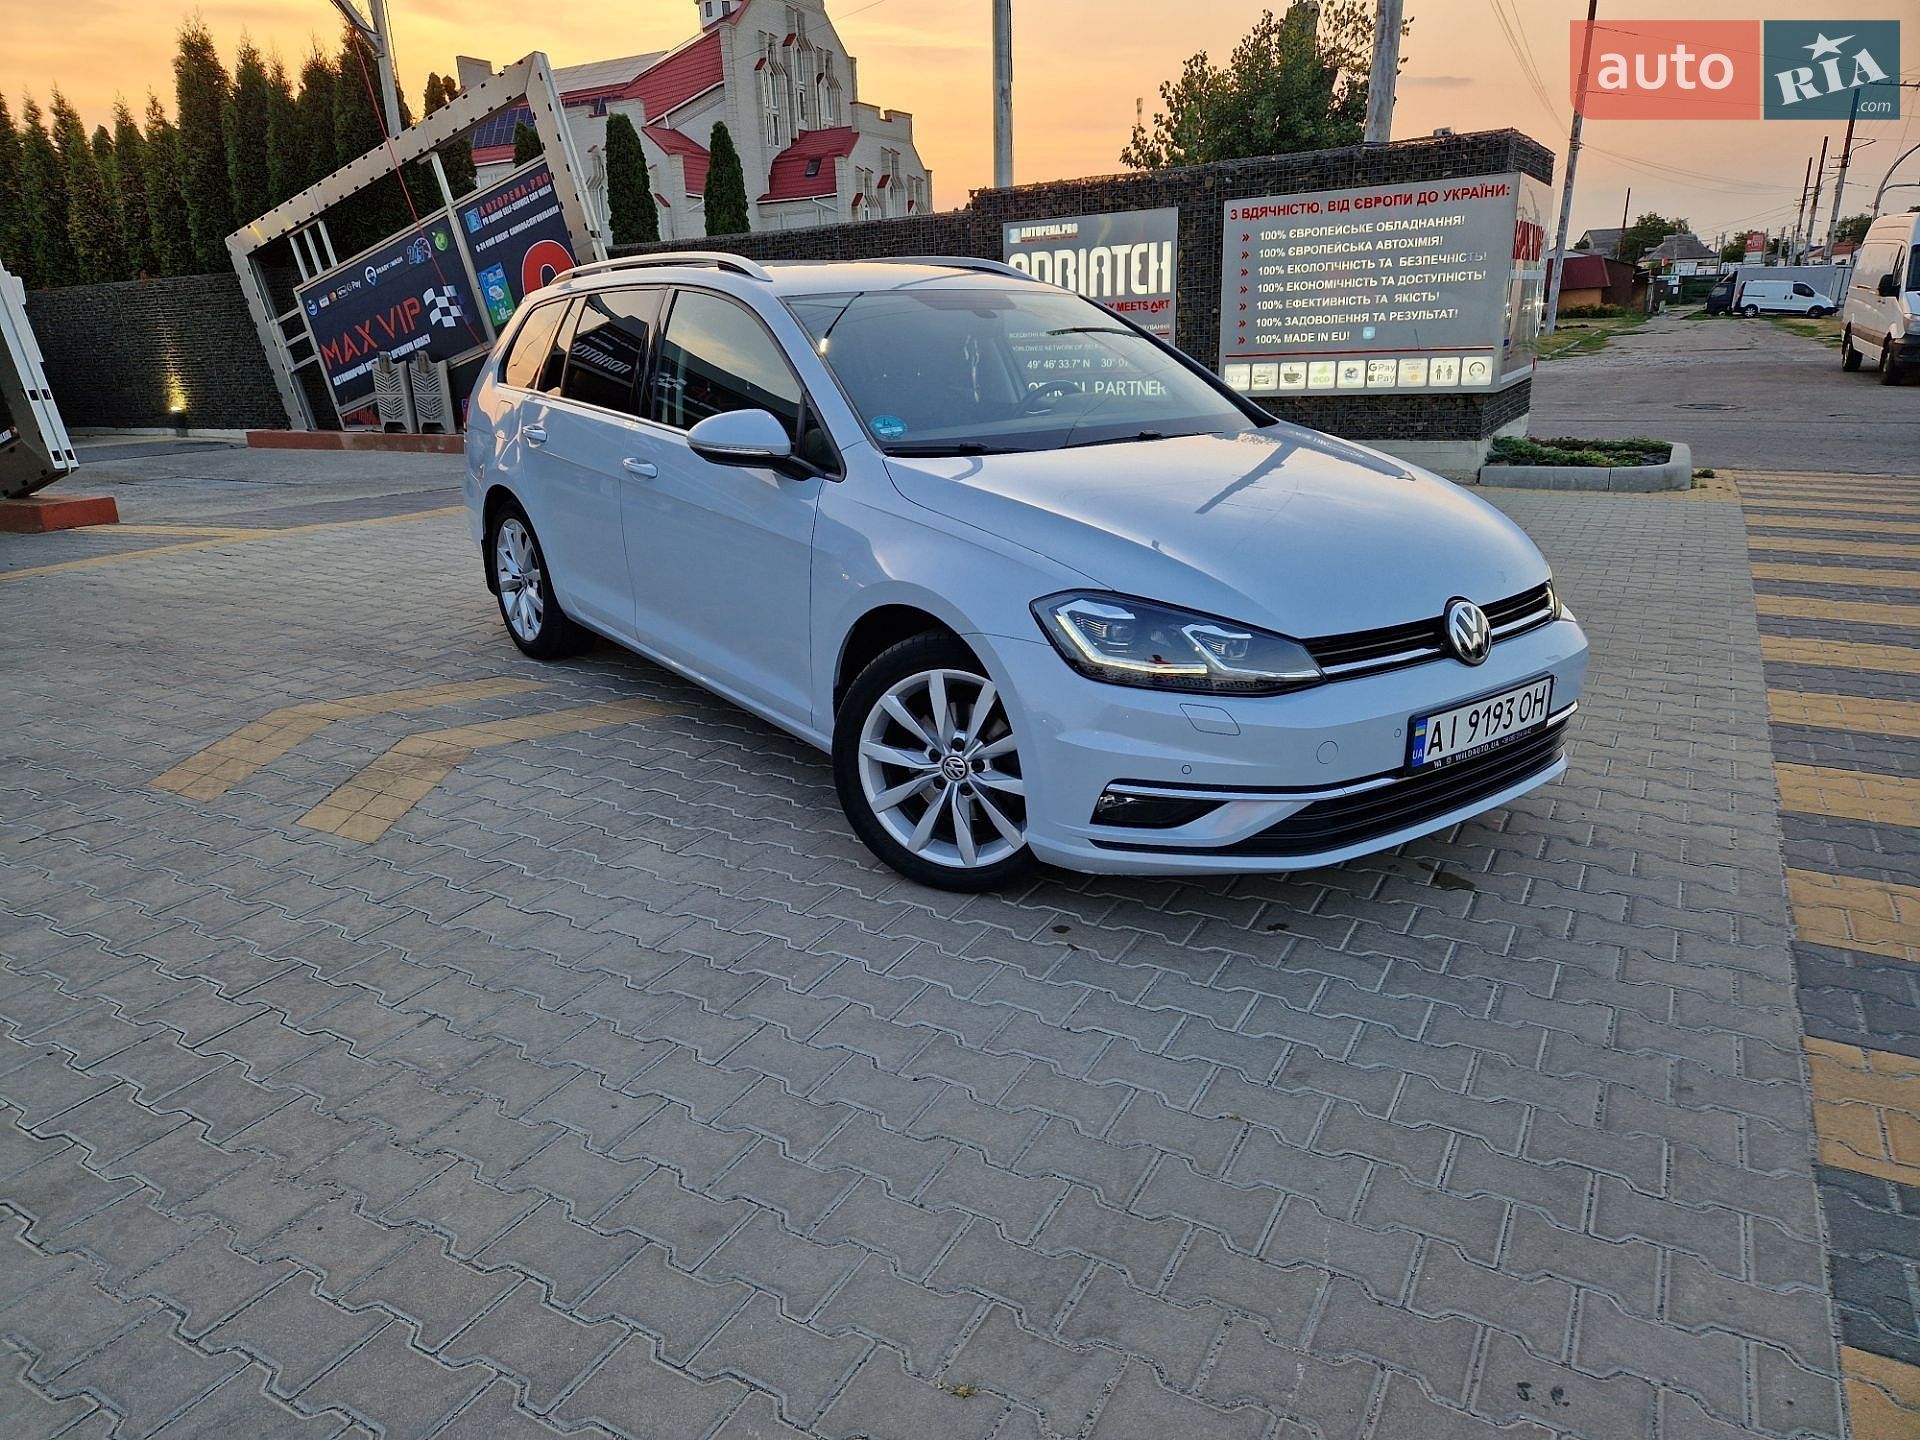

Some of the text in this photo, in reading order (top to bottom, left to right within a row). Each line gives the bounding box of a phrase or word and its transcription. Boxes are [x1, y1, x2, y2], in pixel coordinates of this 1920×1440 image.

[1230, 184, 1510, 220] З ВДЯЧНІСТЮ, ВІД ЄВРОПИ ДО УКРАЇНИ:
[1260, 216, 1465, 240] 100% ЄВРОПЕЙСЬКЕ ОБЛАДНАННЯ!
[1259, 236, 1444, 258] 100% ЄВРОПЕЙСЬКА АВТОХІМІЯ!
[1258, 252, 1487, 276] 100% ЕКОЛОГІЧНІСТЬ ТА БЕЗПЕЧНІСТЬ!
[1257, 270, 1486, 293] 100% ЕКОНОМІЧНІСТЬ ТА ДОСТУПНІСТЬ!
[1116, 301, 1148, 312] MEETS
[1150, 300, 1170, 313] ART
[1257, 292, 1439, 310] 100% ЕФЕКТИВНІСТЬ ТА ЯКІСТЬ!
[1256, 309, 1458, 327] 100% ЗАДОВОЛЕННЯ ТА РЕЗУЛЬТАТ!
[320, 297, 421, 370] MAX VIP
[1255, 331, 1350, 344] 100% MADE IN EU!
[1082, 359, 1090, 368] N
[1379, 363, 1396, 373] Pay
[1378, 374, 1396, 383] Pay
[1095, 381, 1167, 396] PARTNER
[1427, 685, 1546, 756] AI 9193 OH
[1412, 749, 1423, 760] UA
